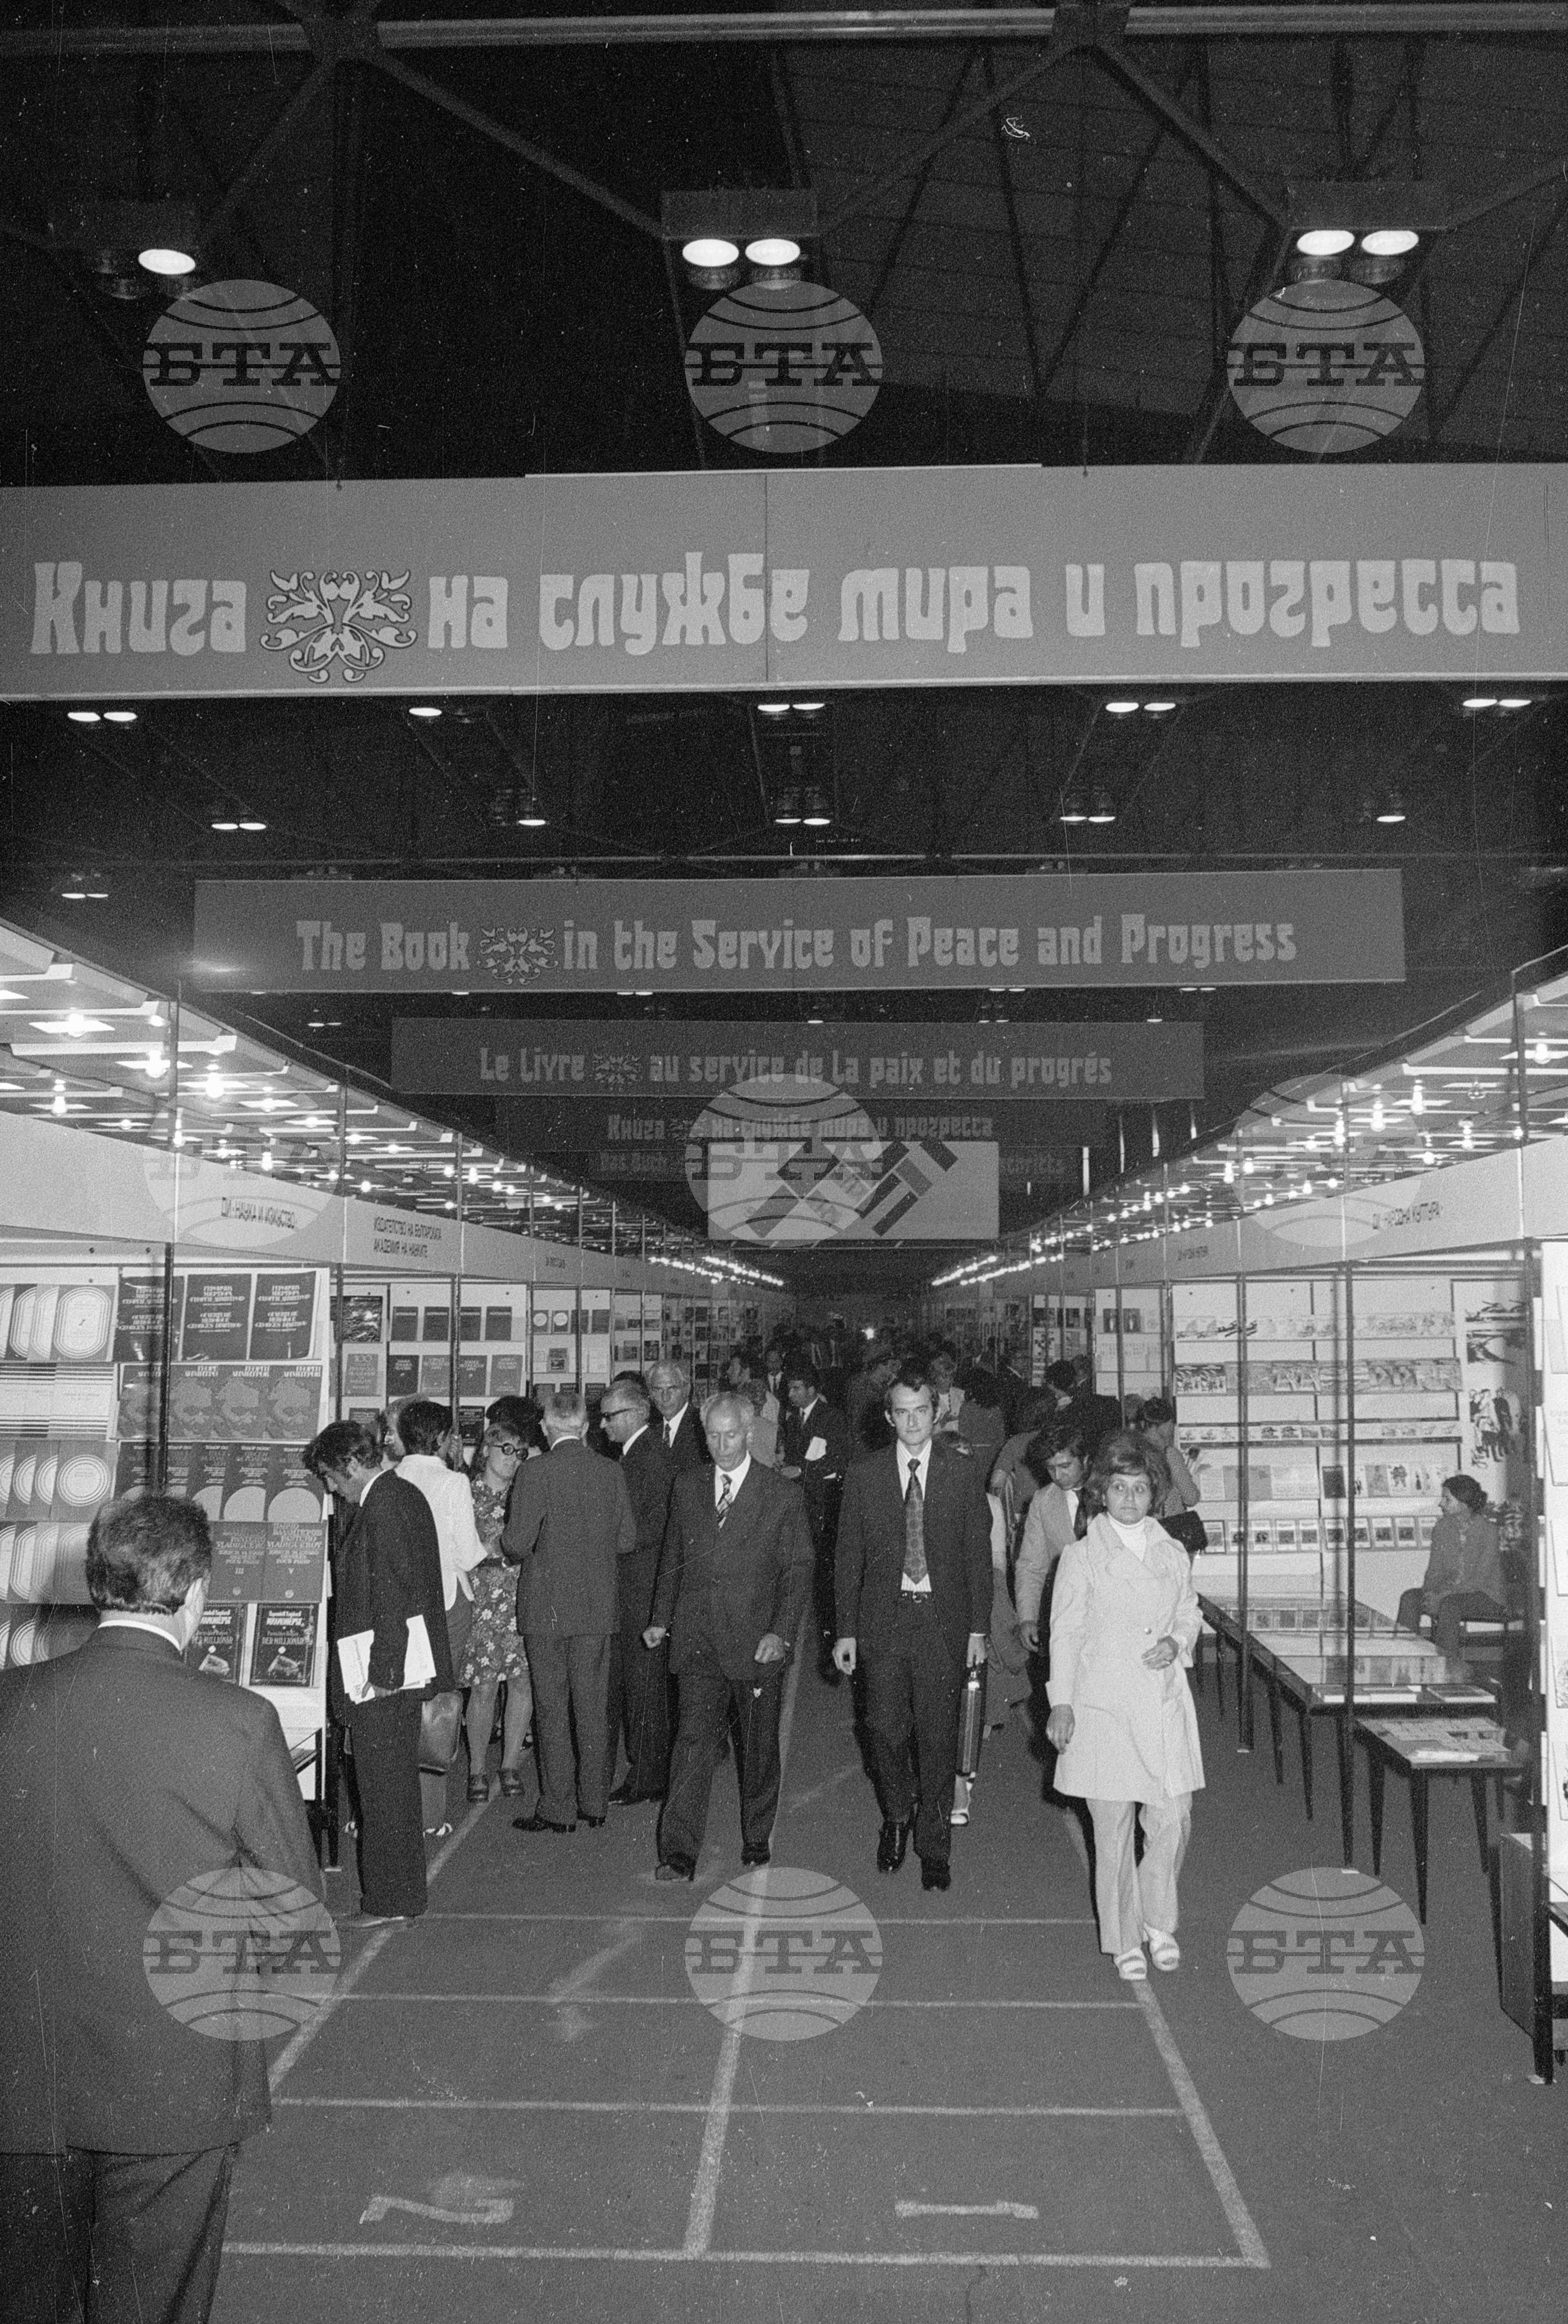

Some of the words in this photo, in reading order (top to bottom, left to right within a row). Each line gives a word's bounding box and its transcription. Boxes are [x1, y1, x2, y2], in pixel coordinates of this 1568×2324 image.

[31, 562, 248, 657] Книга
[428, 575, 509, 649] на
[539, 551, 811, 657] службе
[838, 566, 1034, 654] мира
[1065, 564, 1106, 637] и
[1134, 559, 1520, 648] прогресса
[296, 920, 366, 971] The
[380, 921, 471, 971] Book
[563, 919, 598, 970] in
[613, 920, 677, 970] the
[691, 919, 834, 970] Service
[850, 919, 893, 968] of
[907, 916, 1020, 967] Peace
[1038, 915, 1103, 965] and
[1121, 914, 1297, 969] Progress
[480, 1047, 509, 1082] Le
[650, 1055, 679, 1082] au
[690, 1049, 785, 1083] service
[795, 1050, 824, 1084] de
[869, 1052, 923, 1089] paix
[934, 1050, 961, 1085] et
[971, 1050, 1002, 1085] du
[607, 1114, 665, 1141] Книга
